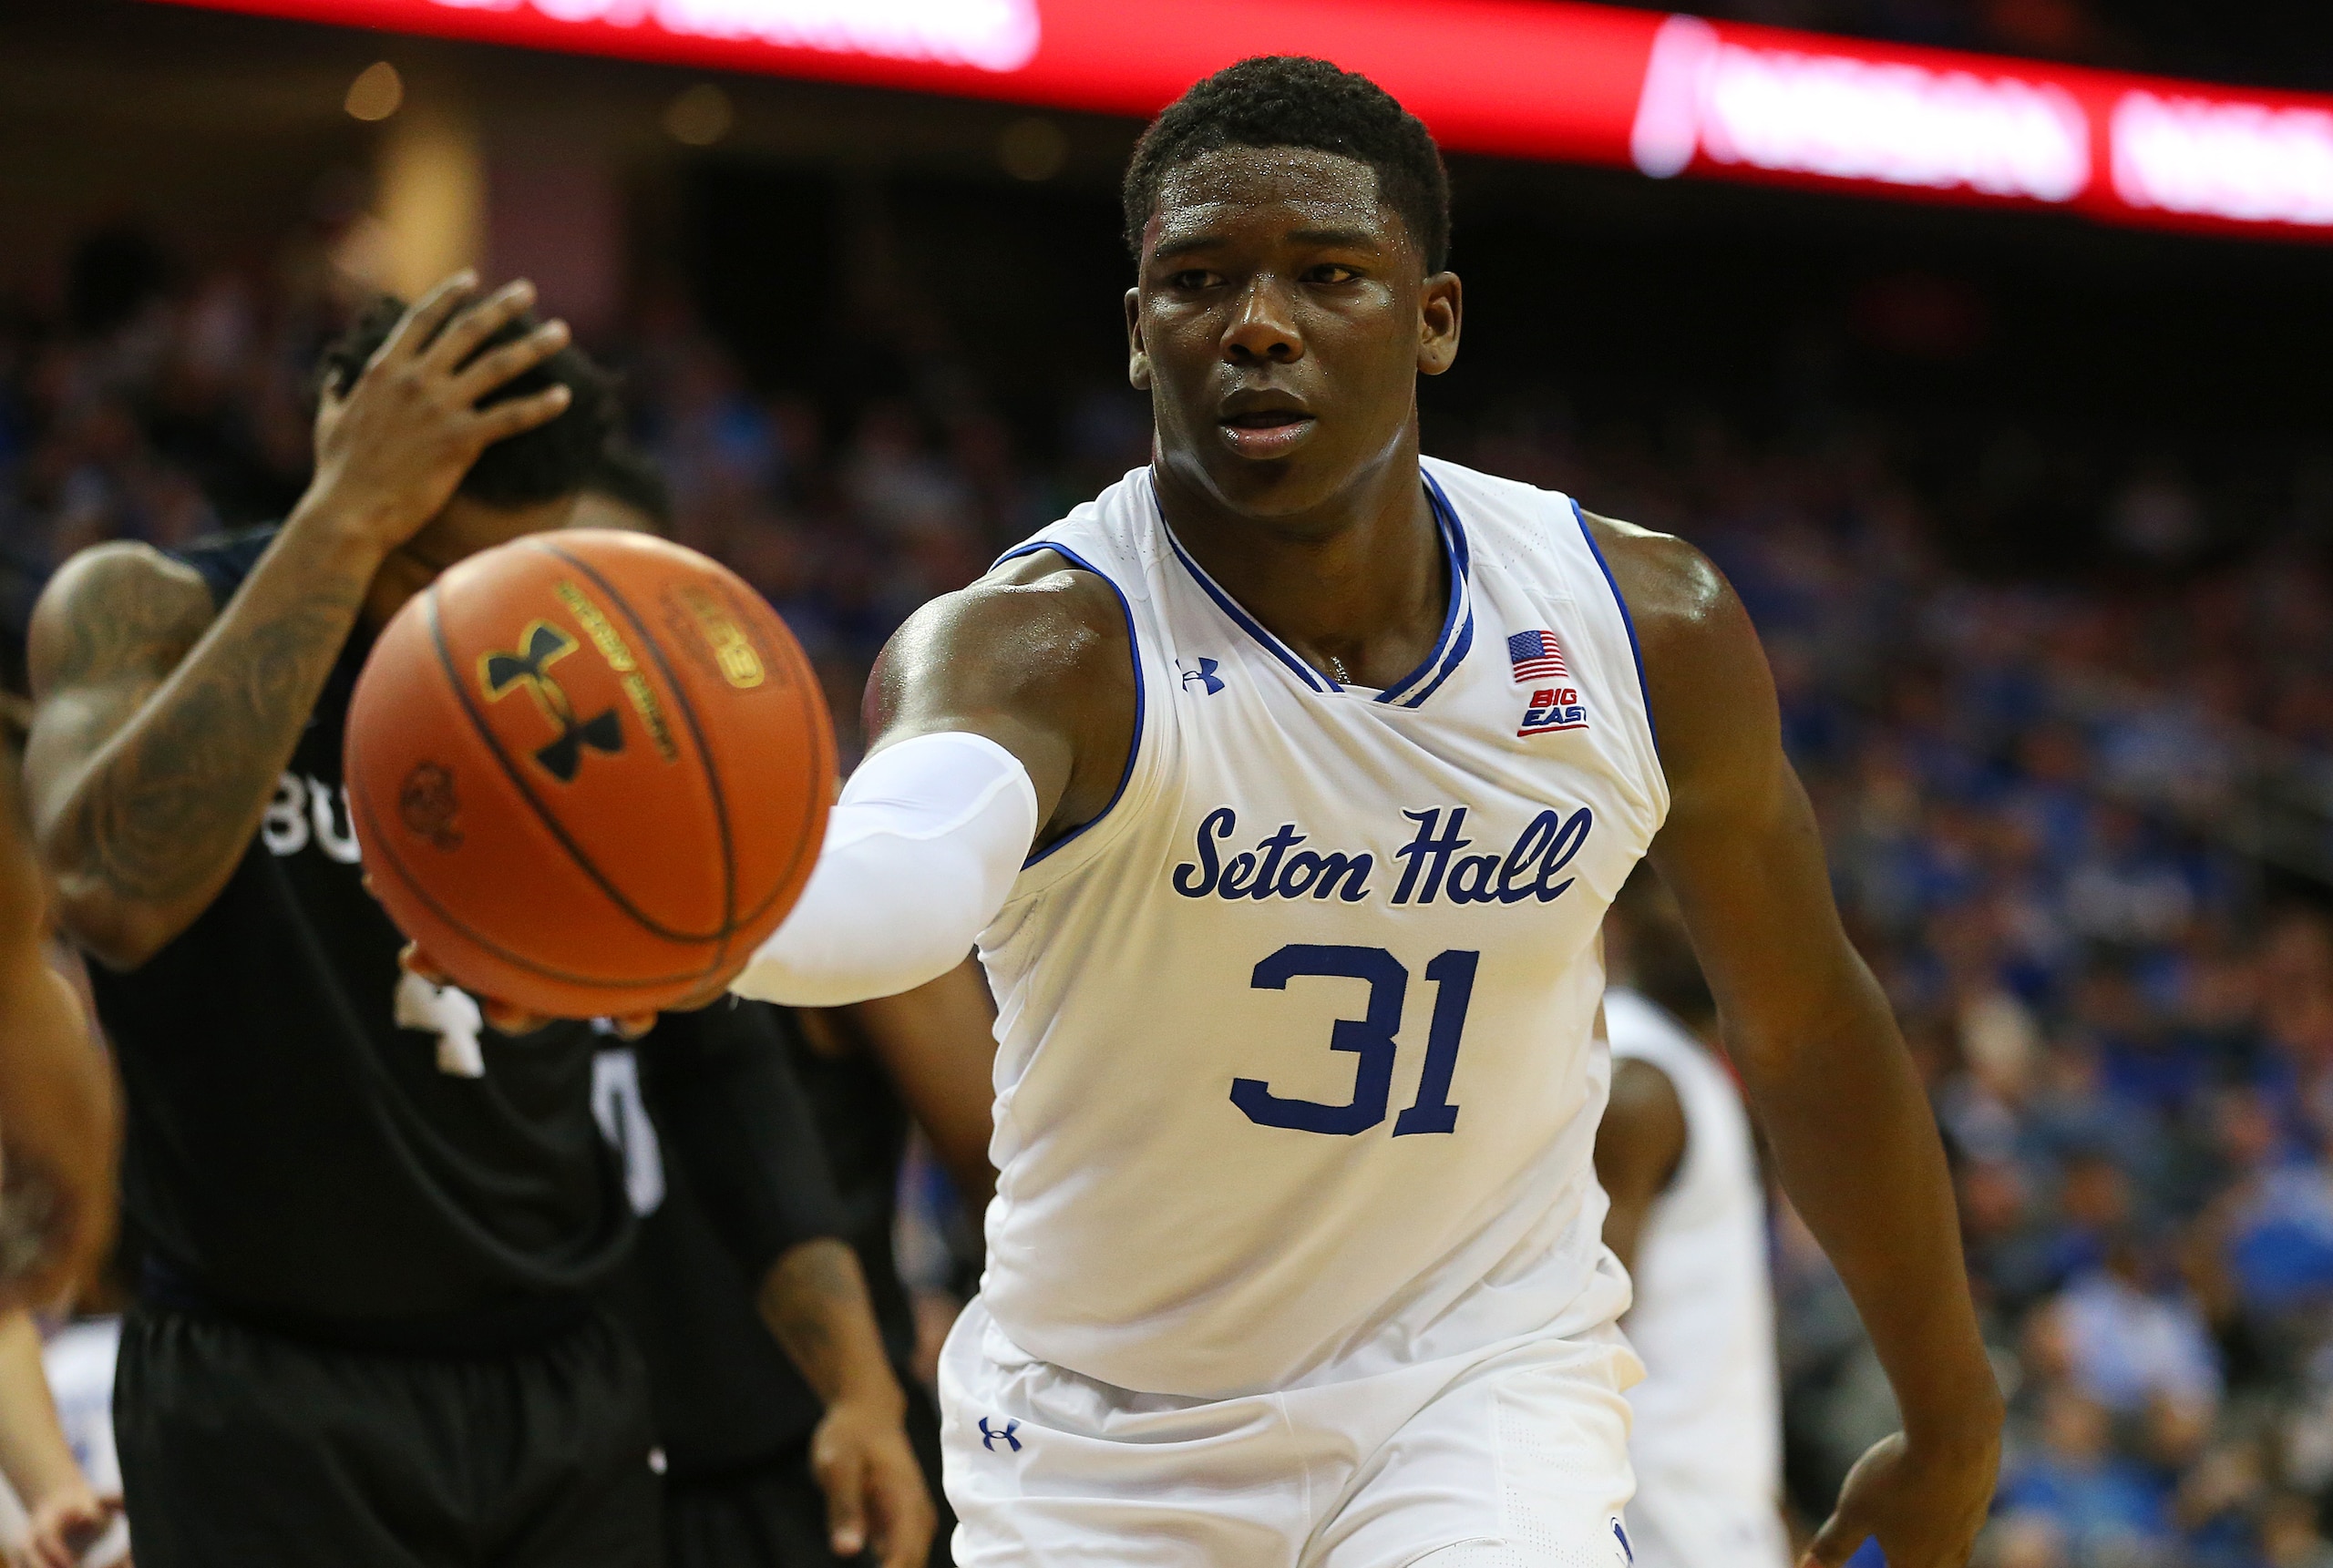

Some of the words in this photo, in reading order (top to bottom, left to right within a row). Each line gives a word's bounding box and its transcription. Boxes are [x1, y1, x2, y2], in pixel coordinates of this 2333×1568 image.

[1528, 688, 1578, 709] BIG
[1172, 806, 1374, 903] Seton
[1391, 806, 1594, 905] Hall
[1228, 943, 1481, 1138] 31
